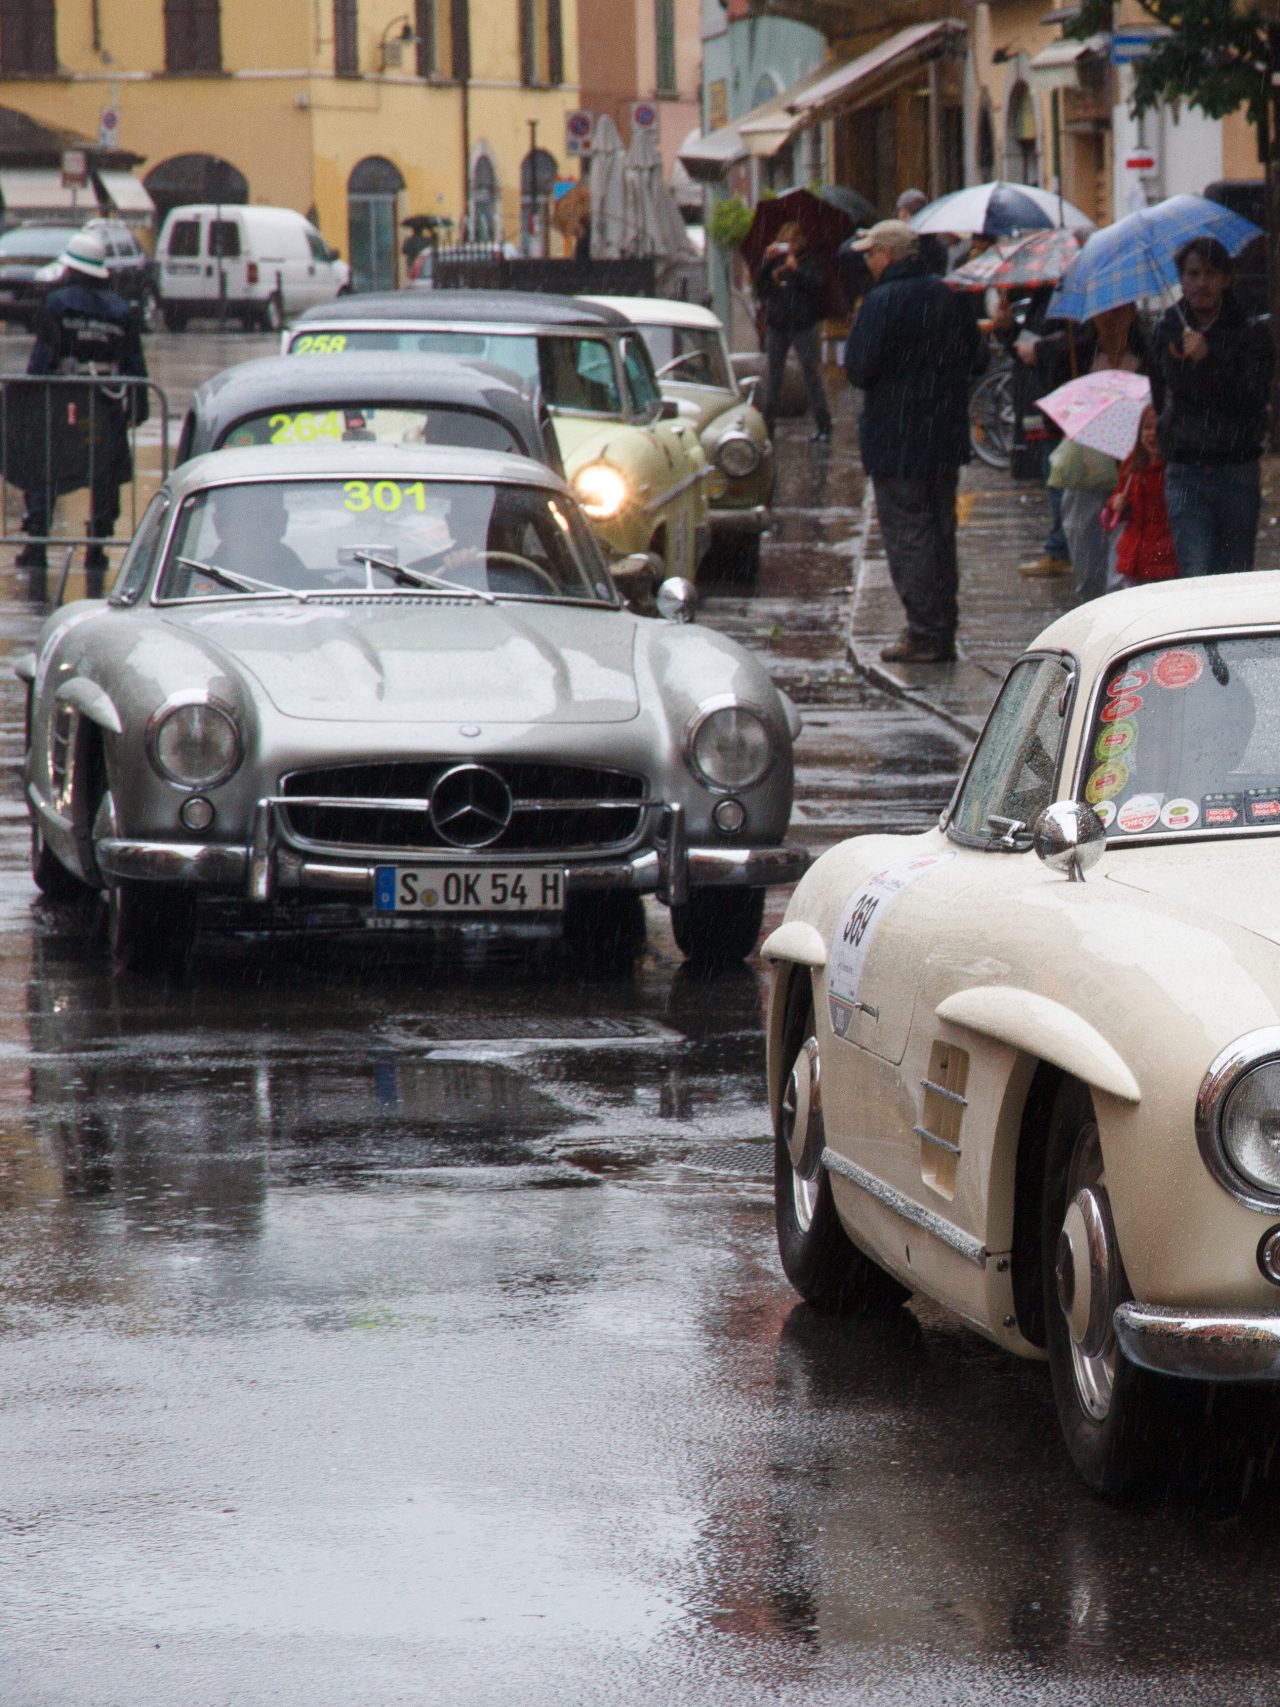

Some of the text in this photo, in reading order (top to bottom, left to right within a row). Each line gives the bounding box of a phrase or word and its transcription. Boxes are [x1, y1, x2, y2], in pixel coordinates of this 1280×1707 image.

[268, 410, 341, 444] 264
[343, 480, 426, 512] 301
[400, 872, 559, 905] S OK 54 H
[843, 894, 879, 947] 369
